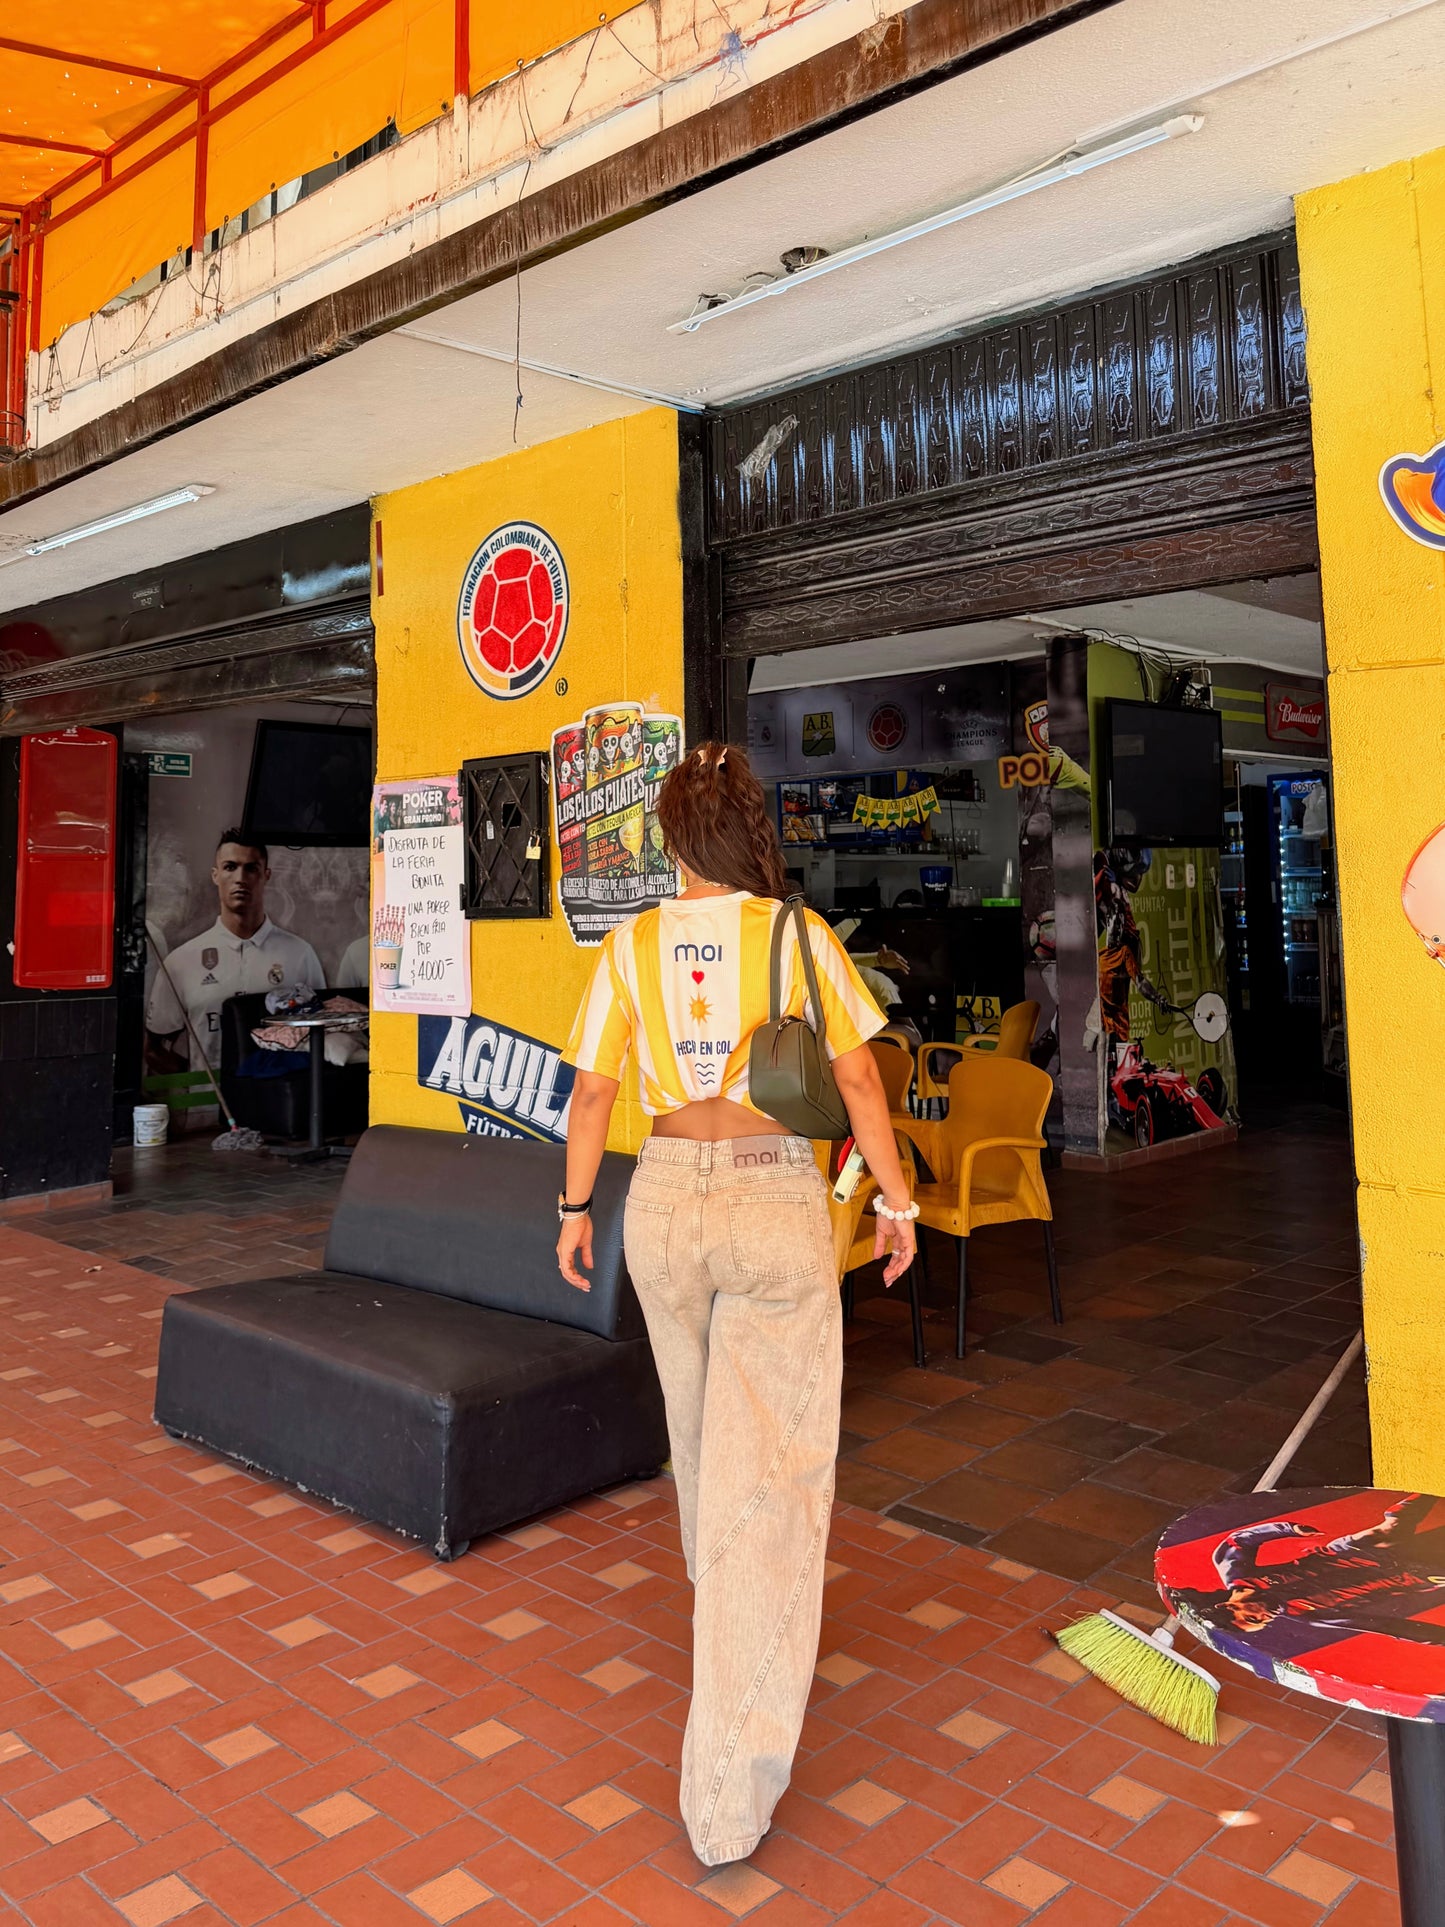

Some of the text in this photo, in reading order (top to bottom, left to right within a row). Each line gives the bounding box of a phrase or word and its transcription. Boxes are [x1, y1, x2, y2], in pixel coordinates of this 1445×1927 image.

[462, 530, 564, 616] FEDERACION COLOMBIANA DE FUTBOL
[1279, 702, 1322, 725] Budweiser
[943, 728, 998, 741] CHAMPIONS
[956, 739, 985, 747] LEAGUE
[585, 788, 604, 818] LOS
[605, 768, 645, 815] CUATES
[1290, 782, 1315, 793] POST
[402, 790, 444, 809] POKER
[404, 813, 442, 824] GRAN PROMO
[558, 797, 575, 825] LOS
[388, 835, 446, 852] DISFRUTA DE
[392, 855, 435, 869] LA FERIA
[411, 873, 445, 890] BONITA
[610, 878, 618, 890] DE
[657, 884, 664, 895] LA
[613, 889, 628, 902] PARA
[628, 888, 636, 900] LA
[407, 899, 450, 916] UNA POKER
[410, 922, 430, 939] BIEN
[417, 940, 431, 956] POR
[380, 962, 397, 970] POKER
[1128, 1001, 1152, 1020] DOR
[700, 1041, 713, 1056] EN
[716, 1040, 733, 1056] COL
